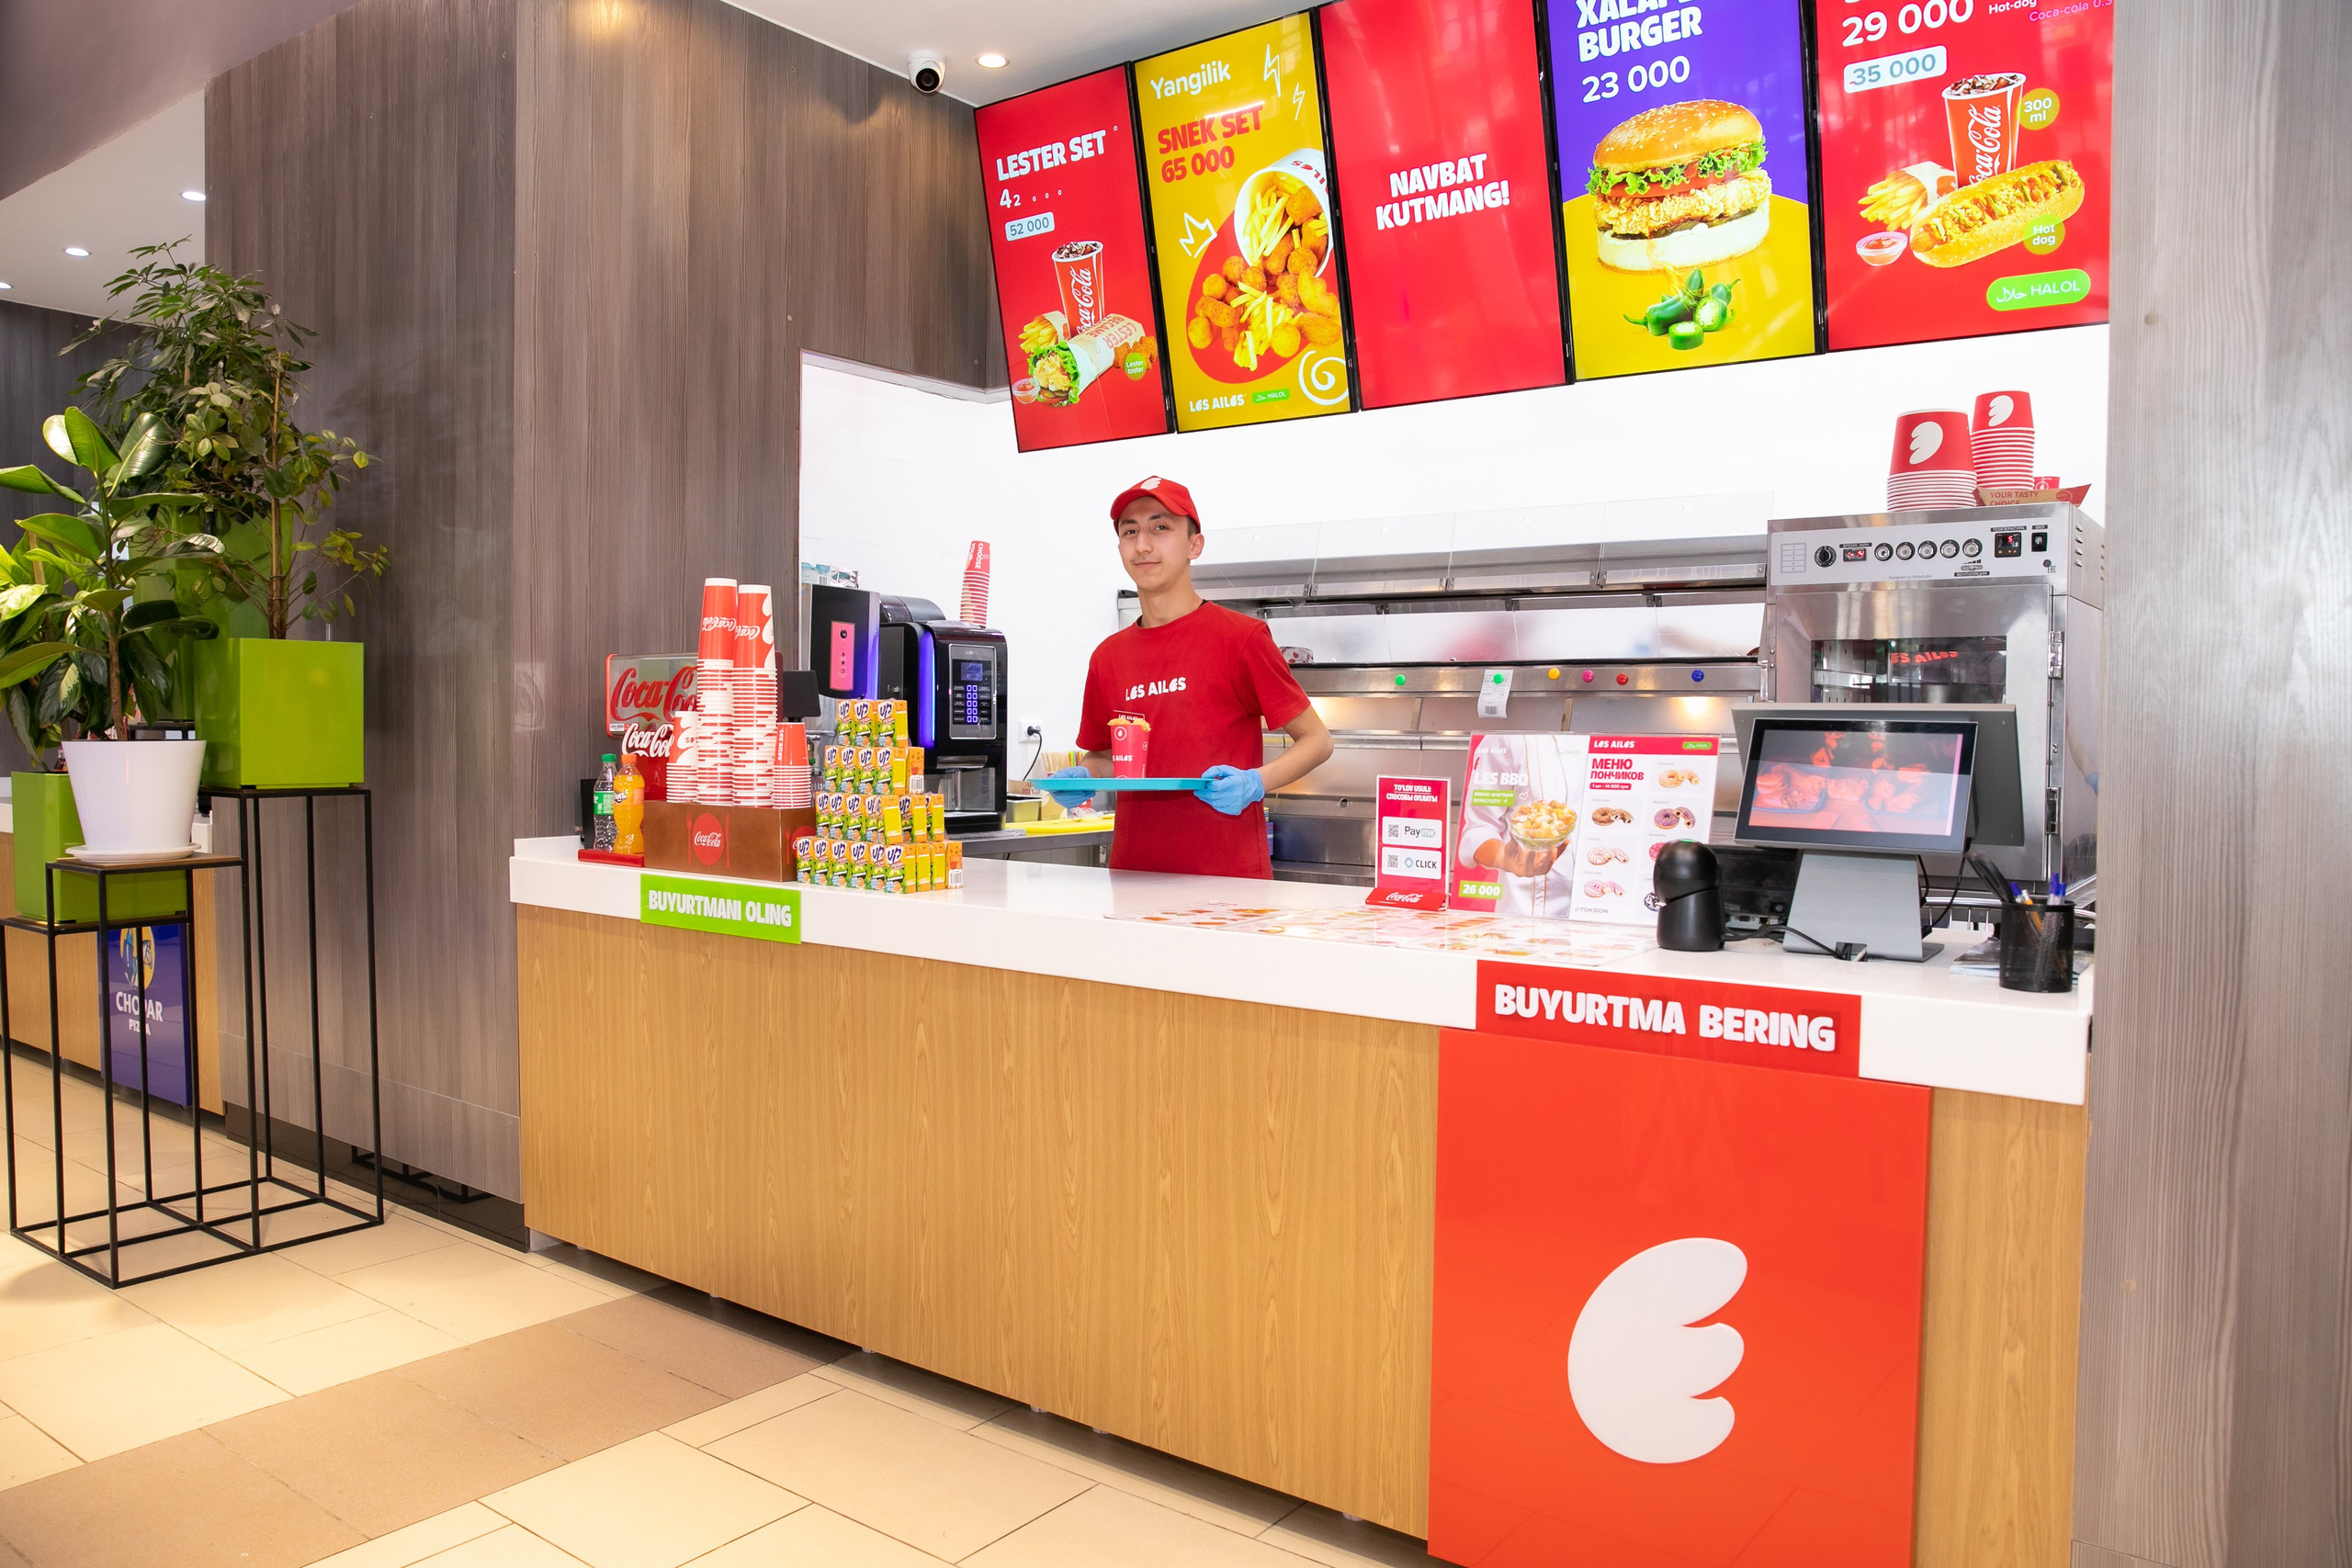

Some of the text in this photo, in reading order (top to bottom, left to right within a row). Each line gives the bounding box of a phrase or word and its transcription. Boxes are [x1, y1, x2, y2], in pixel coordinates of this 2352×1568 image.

[1842, 0, 1973, 47] 29 000
[2029, 2, 2089, 22] Coca-cola
[1578, 6, 1703, 62] BURGER
[1150, 61, 1231, 99] Yangilik
[1582, 55, 1690, 103] 23 000
[1852, 53, 1936, 86] 35 000
[2024, 97, 2052, 112] 300
[2030, 110, 2046, 123] ml
[1158, 105, 1262, 154] SNEK SET
[996, 130, 1106, 182] LESTER SET
[1161, 145, 1235, 184] 65 000
[1389, 152, 1487, 198] NAVBAT
[1376, 180, 1510, 230] KUTMANG!
[1011, 217, 1049, 236] 52 000
[2033, 224, 2055, 235] Hot
[2032, 235, 2056, 246] dog
[2030, 280, 2081, 297] HALOL
[1102, 321, 1137, 349] LESTER
[1189, 394, 1245, 412] LES AILES
[975, 543, 983, 570] CHOOSE
[1125, 677, 1187, 702] LES AILES
[1590, 771, 1645, 781] ПОНЧИКОВ
[1591, 759, 1633, 770] МЕНЮ
[1475, 773, 1529, 786] LES BBQ
[1415, 860, 1437, 869] CLICK
[1463, 884, 1501, 897] 26 000
[649, 889, 792, 928] BUYURTMANI OLING
[129, 1018, 151, 1036] PIZA
[1494, 983, 1836, 1053] BUYURTMA BERING
